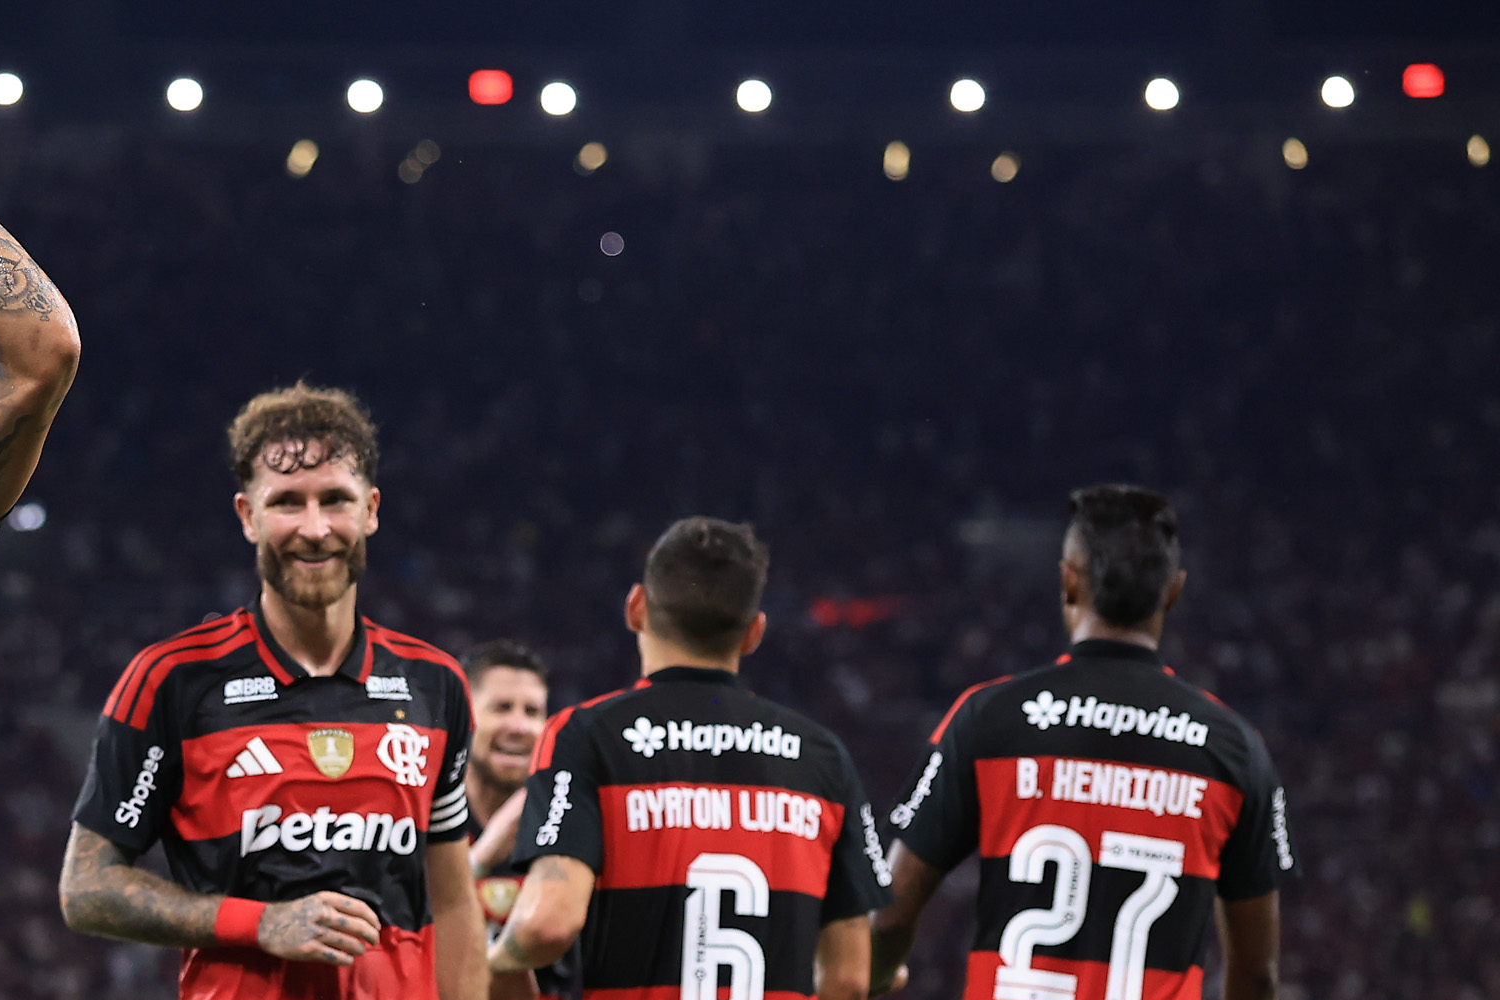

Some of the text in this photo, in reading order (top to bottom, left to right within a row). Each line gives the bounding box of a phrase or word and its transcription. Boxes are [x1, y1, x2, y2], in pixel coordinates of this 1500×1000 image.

[667, 719, 802, 761] Hapvida
[1065, 696, 1210, 747] Hapvida
[114, 745, 165, 829] Shopee
[626, 786, 823, 841] AYRTON LUCAS
[1016, 757, 1208, 819] B. HENRIQUE
[240, 804, 418, 858] Betano
